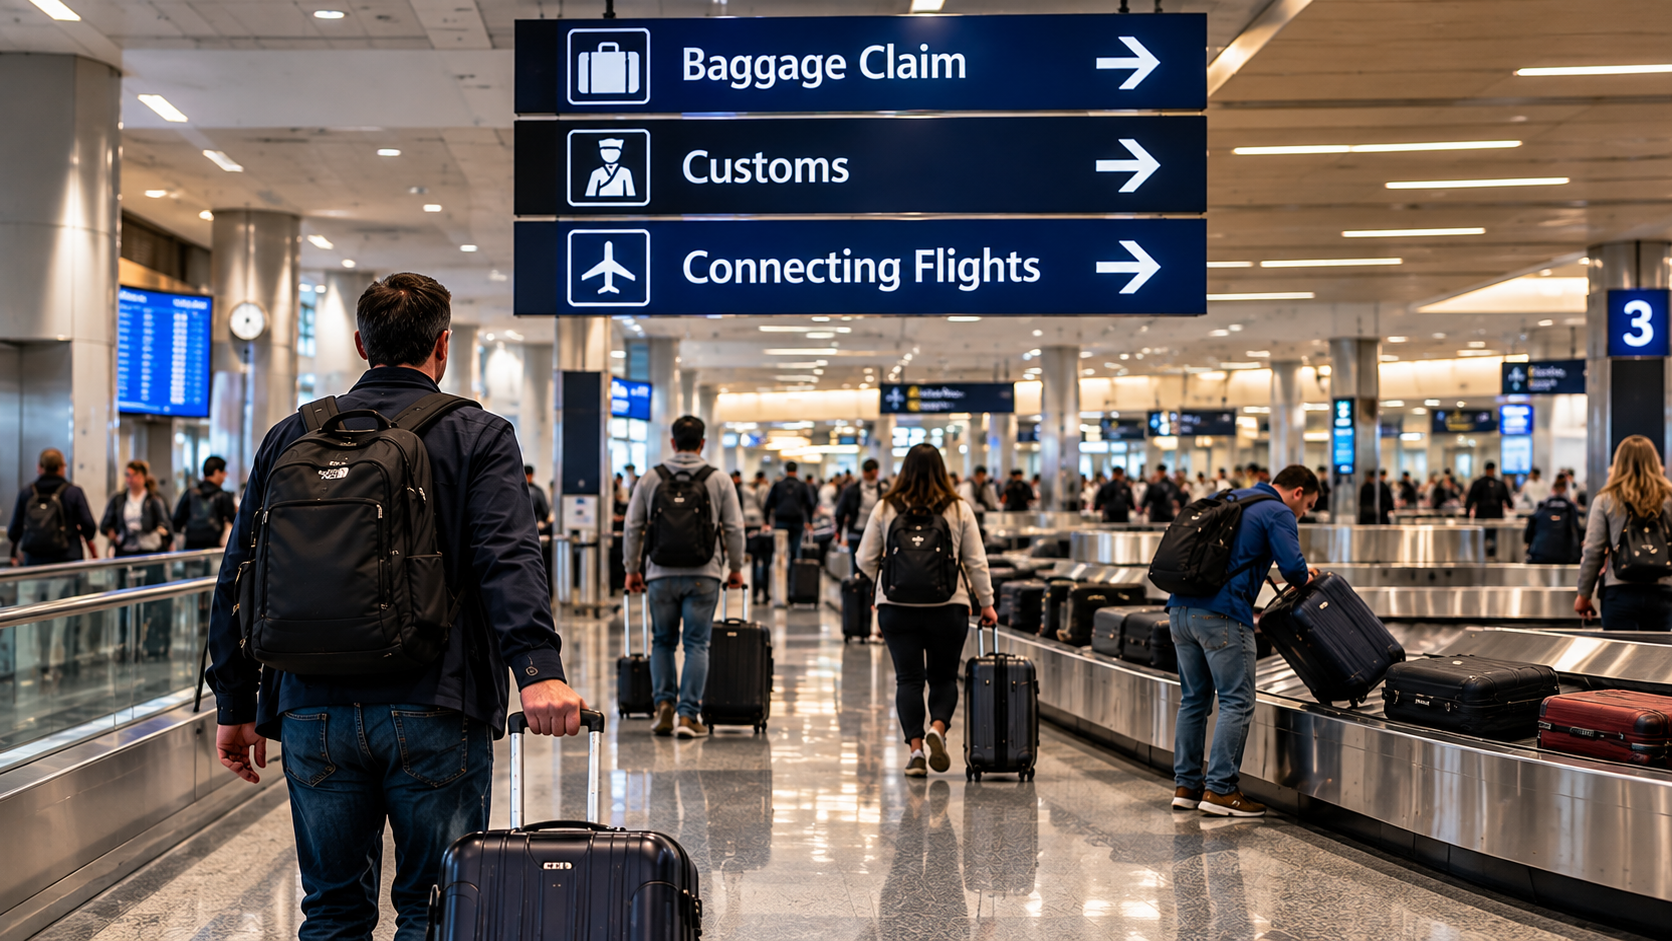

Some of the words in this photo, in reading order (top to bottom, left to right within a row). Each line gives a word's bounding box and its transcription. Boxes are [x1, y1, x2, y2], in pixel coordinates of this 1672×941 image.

[683, 47, 847, 90] Baggage
[859, 43, 967, 80] Claim
[682, 150, 850, 184] Customs
[682, 247, 901, 292] Connecting
[915, 246, 1041, 292] Flights
[1622, 299, 1655, 347] 3
